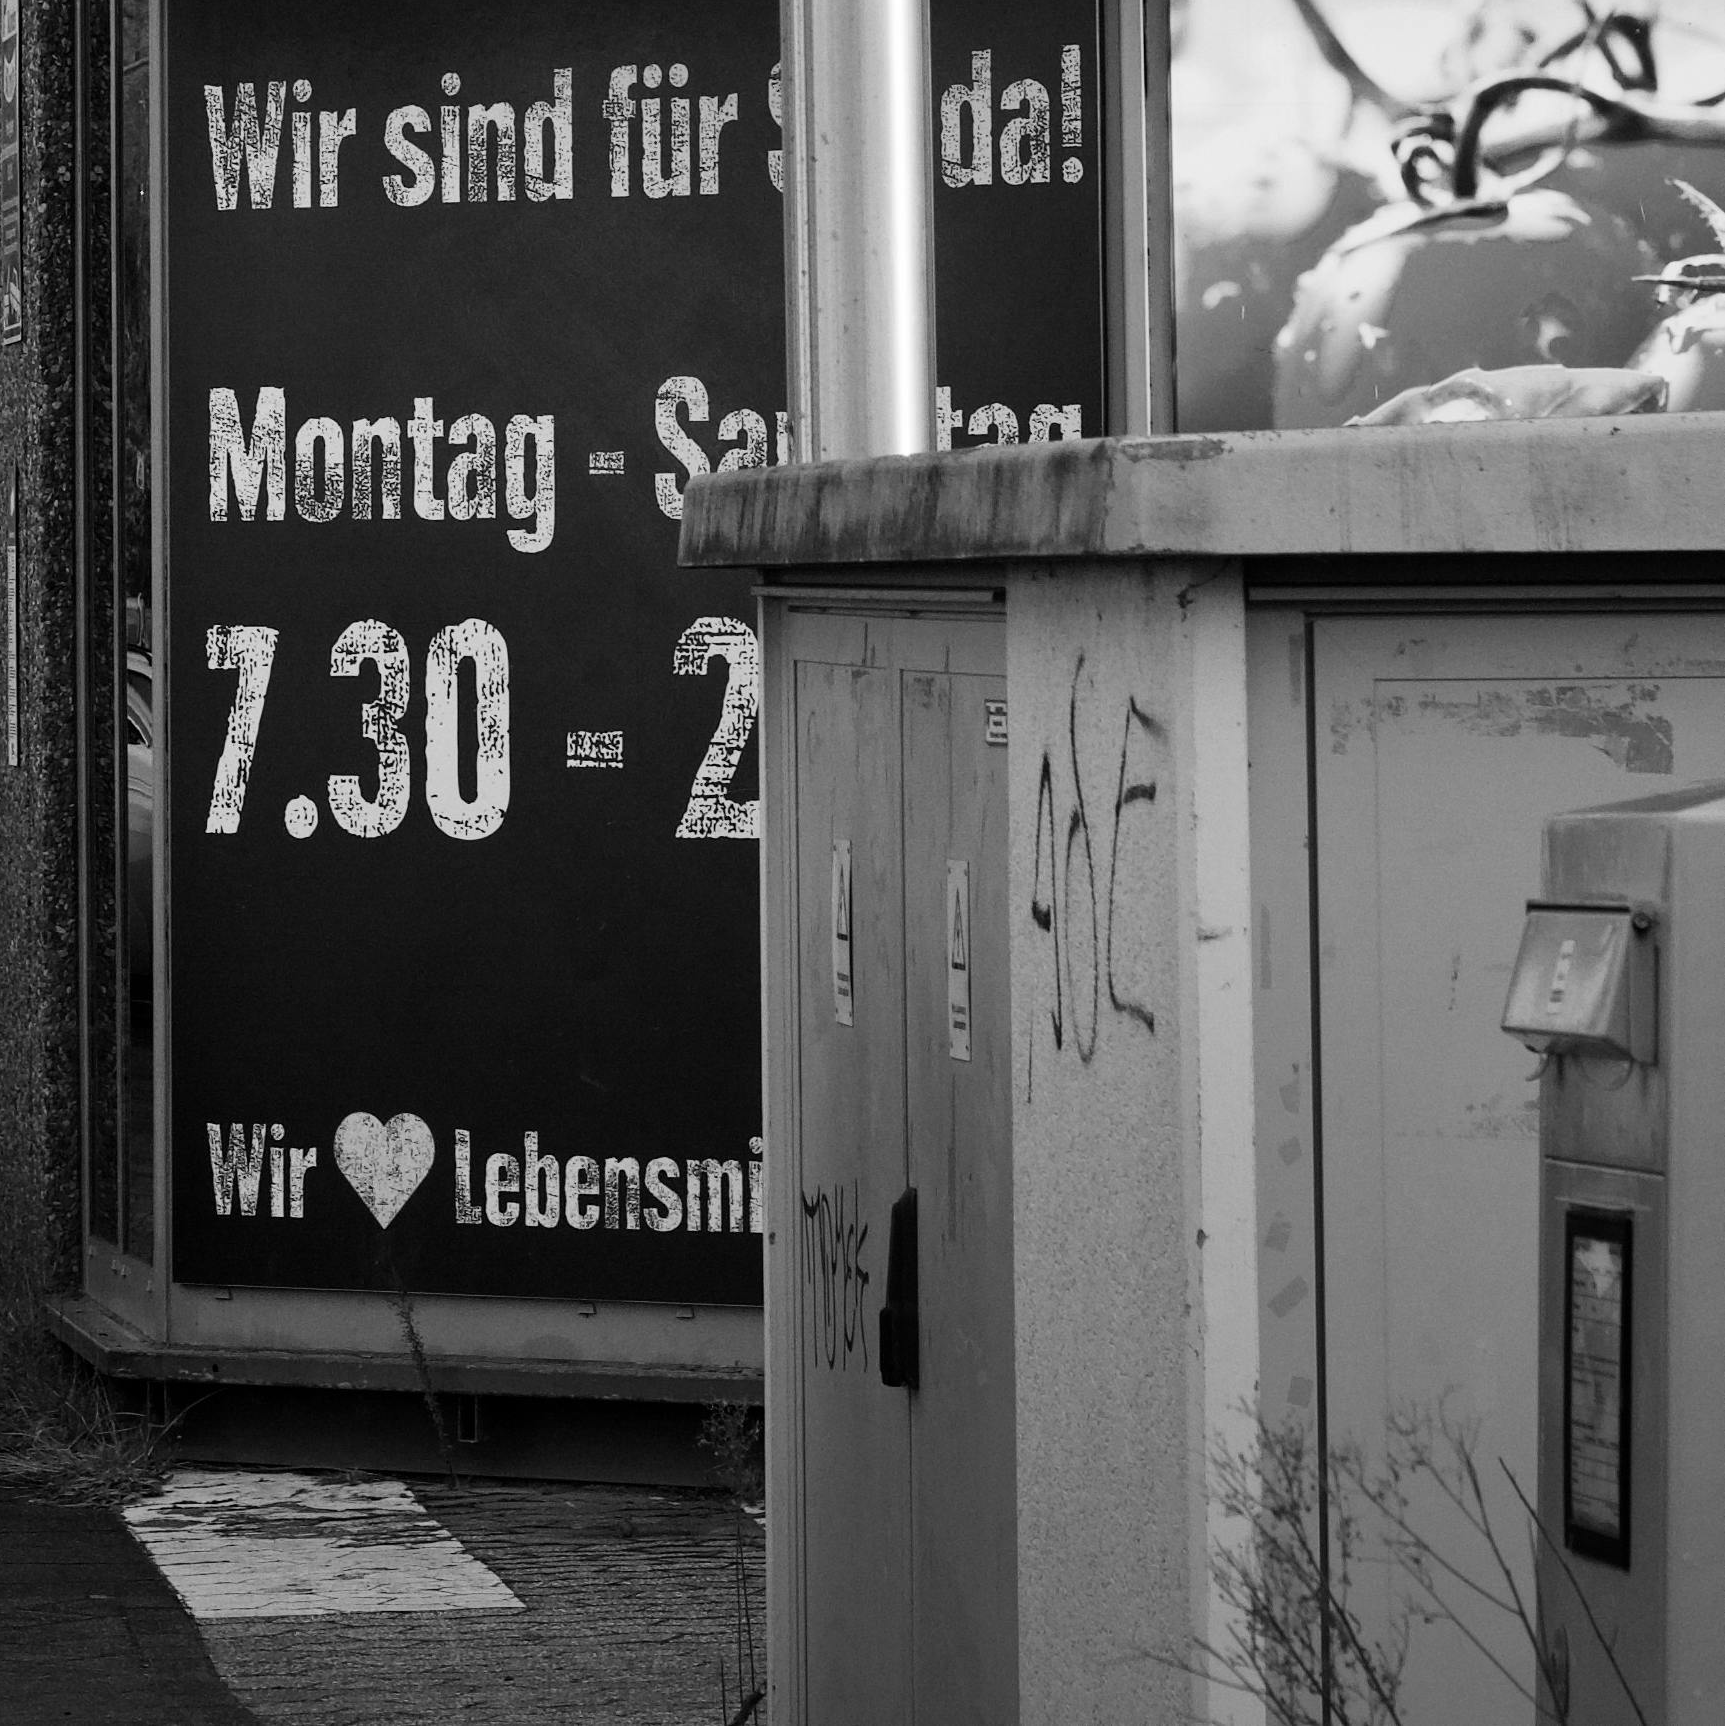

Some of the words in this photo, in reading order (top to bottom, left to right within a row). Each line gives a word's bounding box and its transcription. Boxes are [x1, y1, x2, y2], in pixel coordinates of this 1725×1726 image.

[203, 79, 357, 211] Wir
[382, 67, 574, 207] sind
[601, 63, 739, 199] für
[940, 44, 1084, 189] da!
[208, 386, 556, 554] Montag
[205, 617, 511, 841] 7.30
[206, 1122, 317, 1219] Wir
[454, 1128, 762, 1234] Lebensmi
